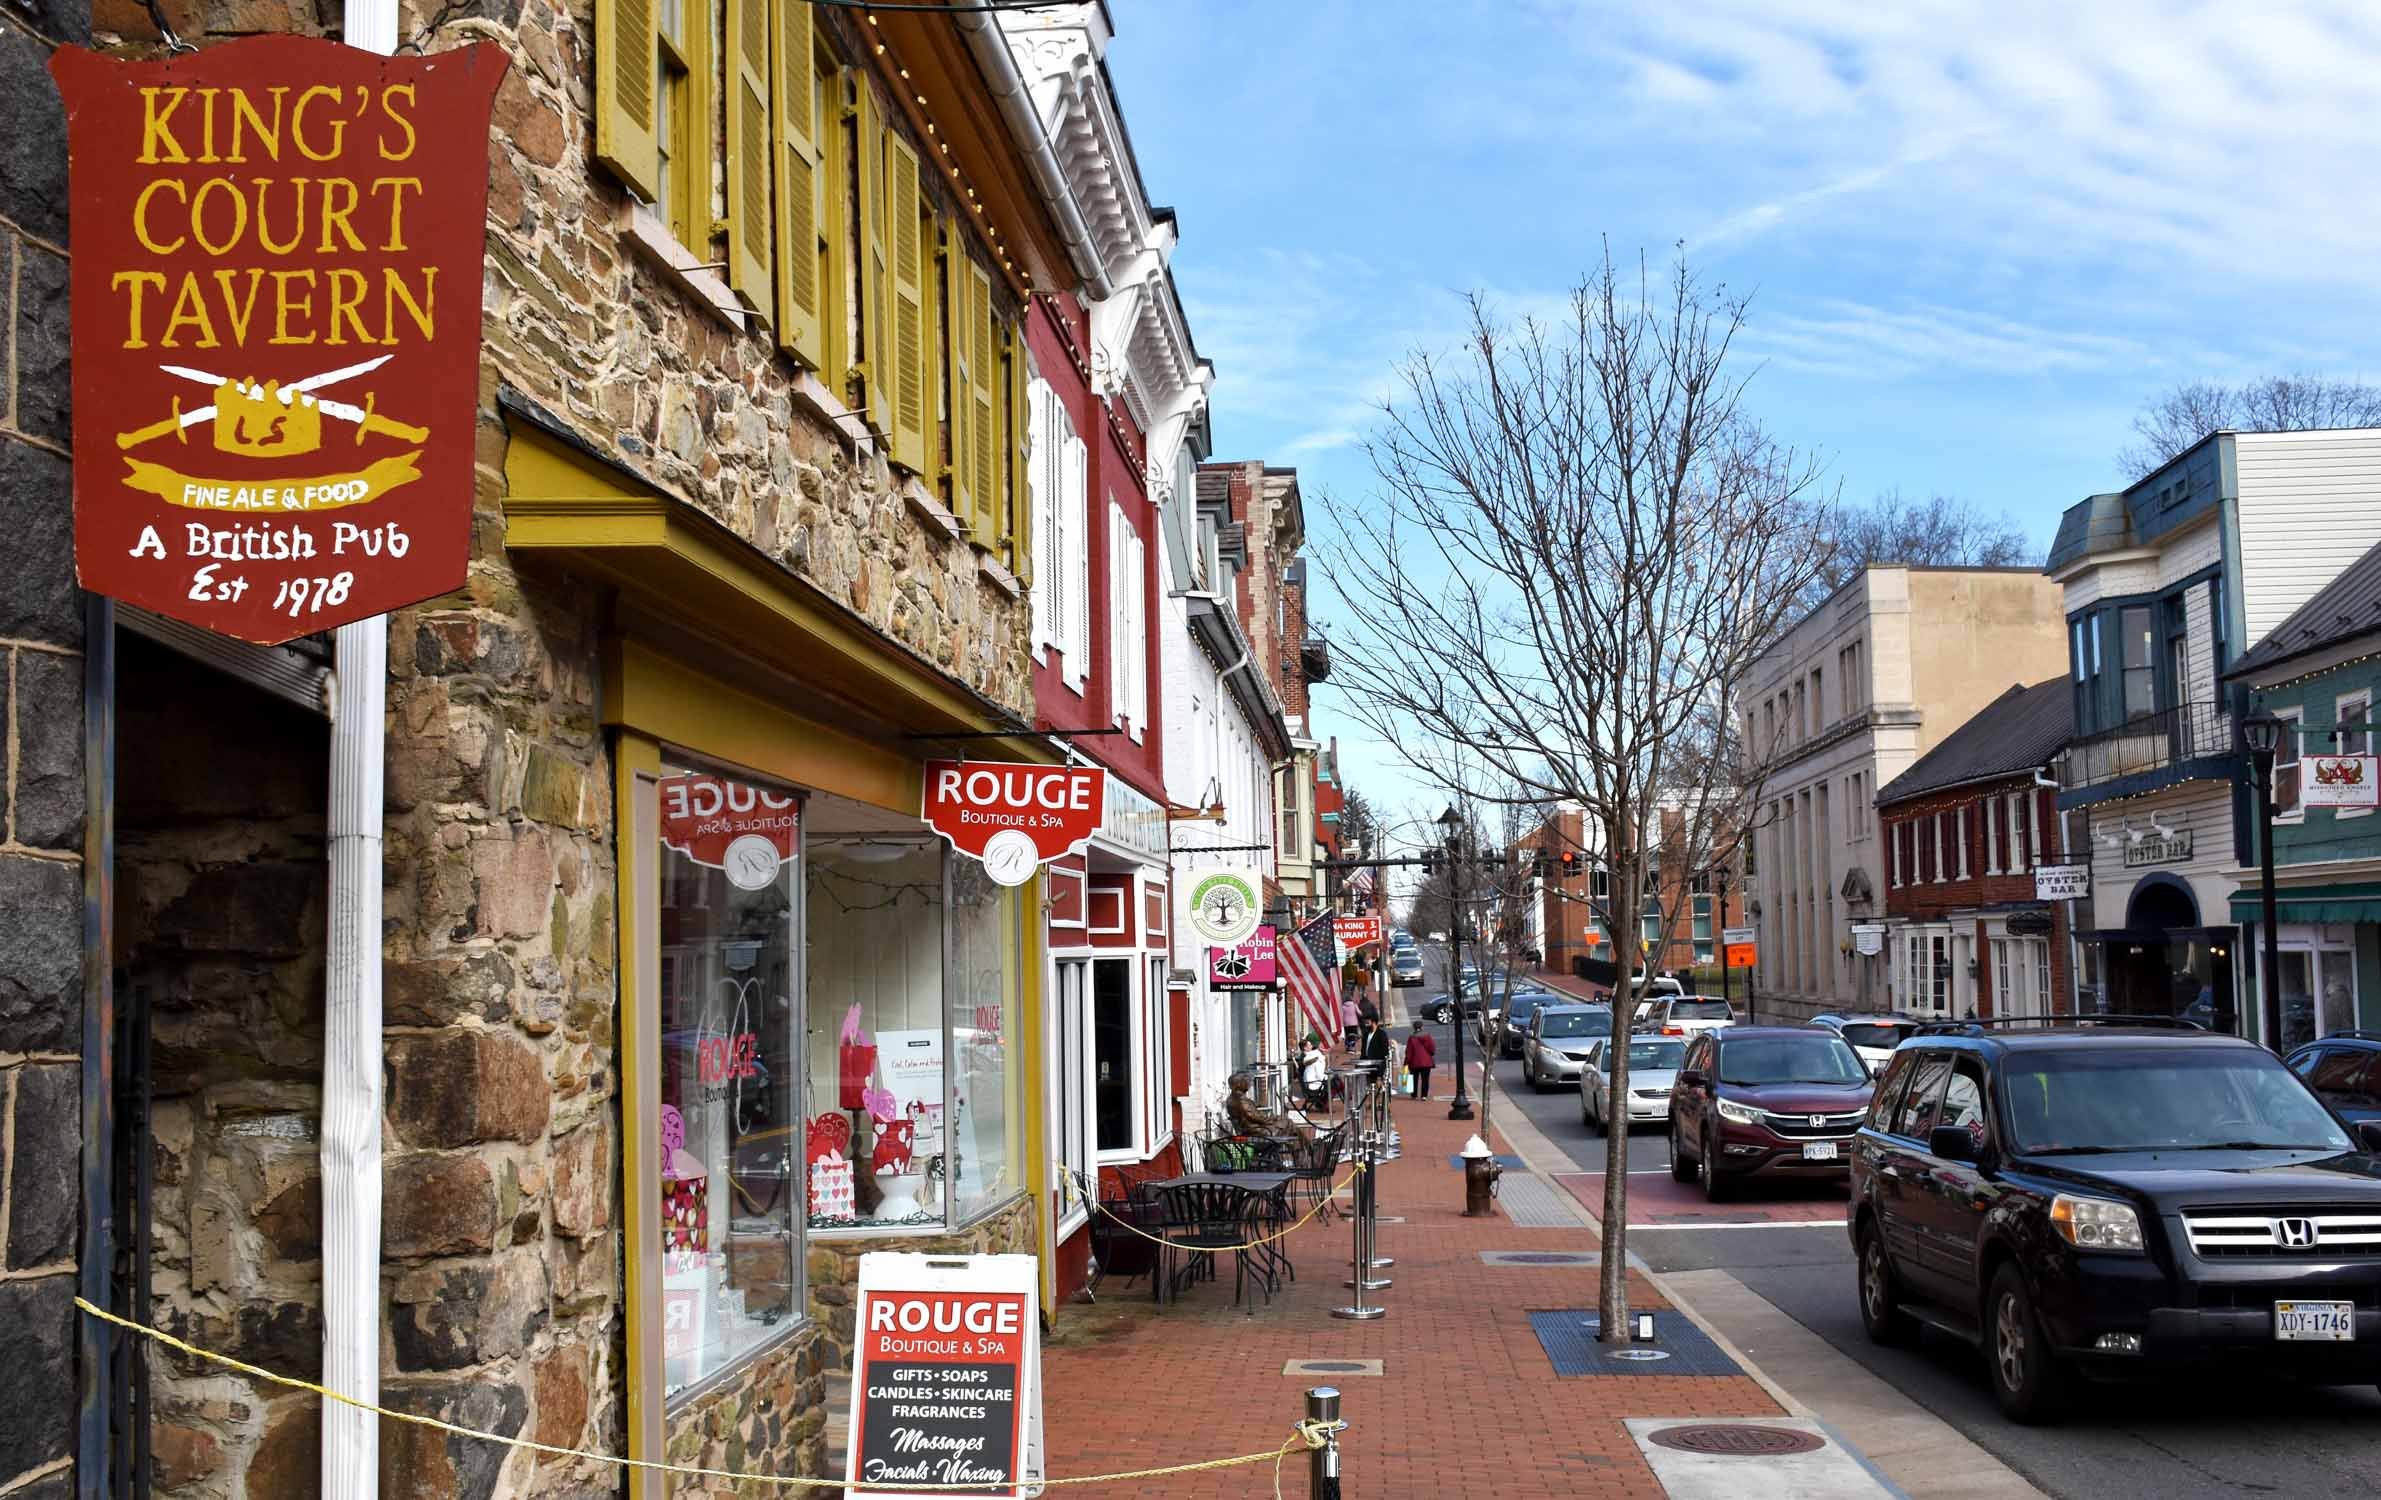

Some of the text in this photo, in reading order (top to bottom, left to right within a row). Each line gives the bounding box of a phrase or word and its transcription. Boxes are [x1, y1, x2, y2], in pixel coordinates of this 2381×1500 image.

[135, 85, 417, 164] KING'S
[132, 177, 423, 256] COURT
[111, 266, 440, 349] TAVERN
[183, 480, 369, 510] FINE ALE & FOOD
[128, 522, 410, 562] A British Pub
[188, 563, 355, 617] Est 1978
[937, 769, 1091, 810] ROUGE
[961, 808, 1065, 828] BOUTIQUE & SPA
[2128, 844, 2164, 863] OYSTER
[2166, 839, 2187, 858] BAR
[2038, 875, 2088, 885] OYSTER
[2050, 885, 2077, 894] BAR
[1344, 922, 1365, 930] KING
[1253, 946, 1274, 960] Lee
[870, 1300, 1019, 1333] ROUGE
[2280, 1313, 2349, 1331] XDY-1746
[880, 1335, 1005, 1355] BOUTIQUE & SPA
[892, 1405, 986, 1419] FRAGRANCES
[890, 1426, 985, 1459] Massages
